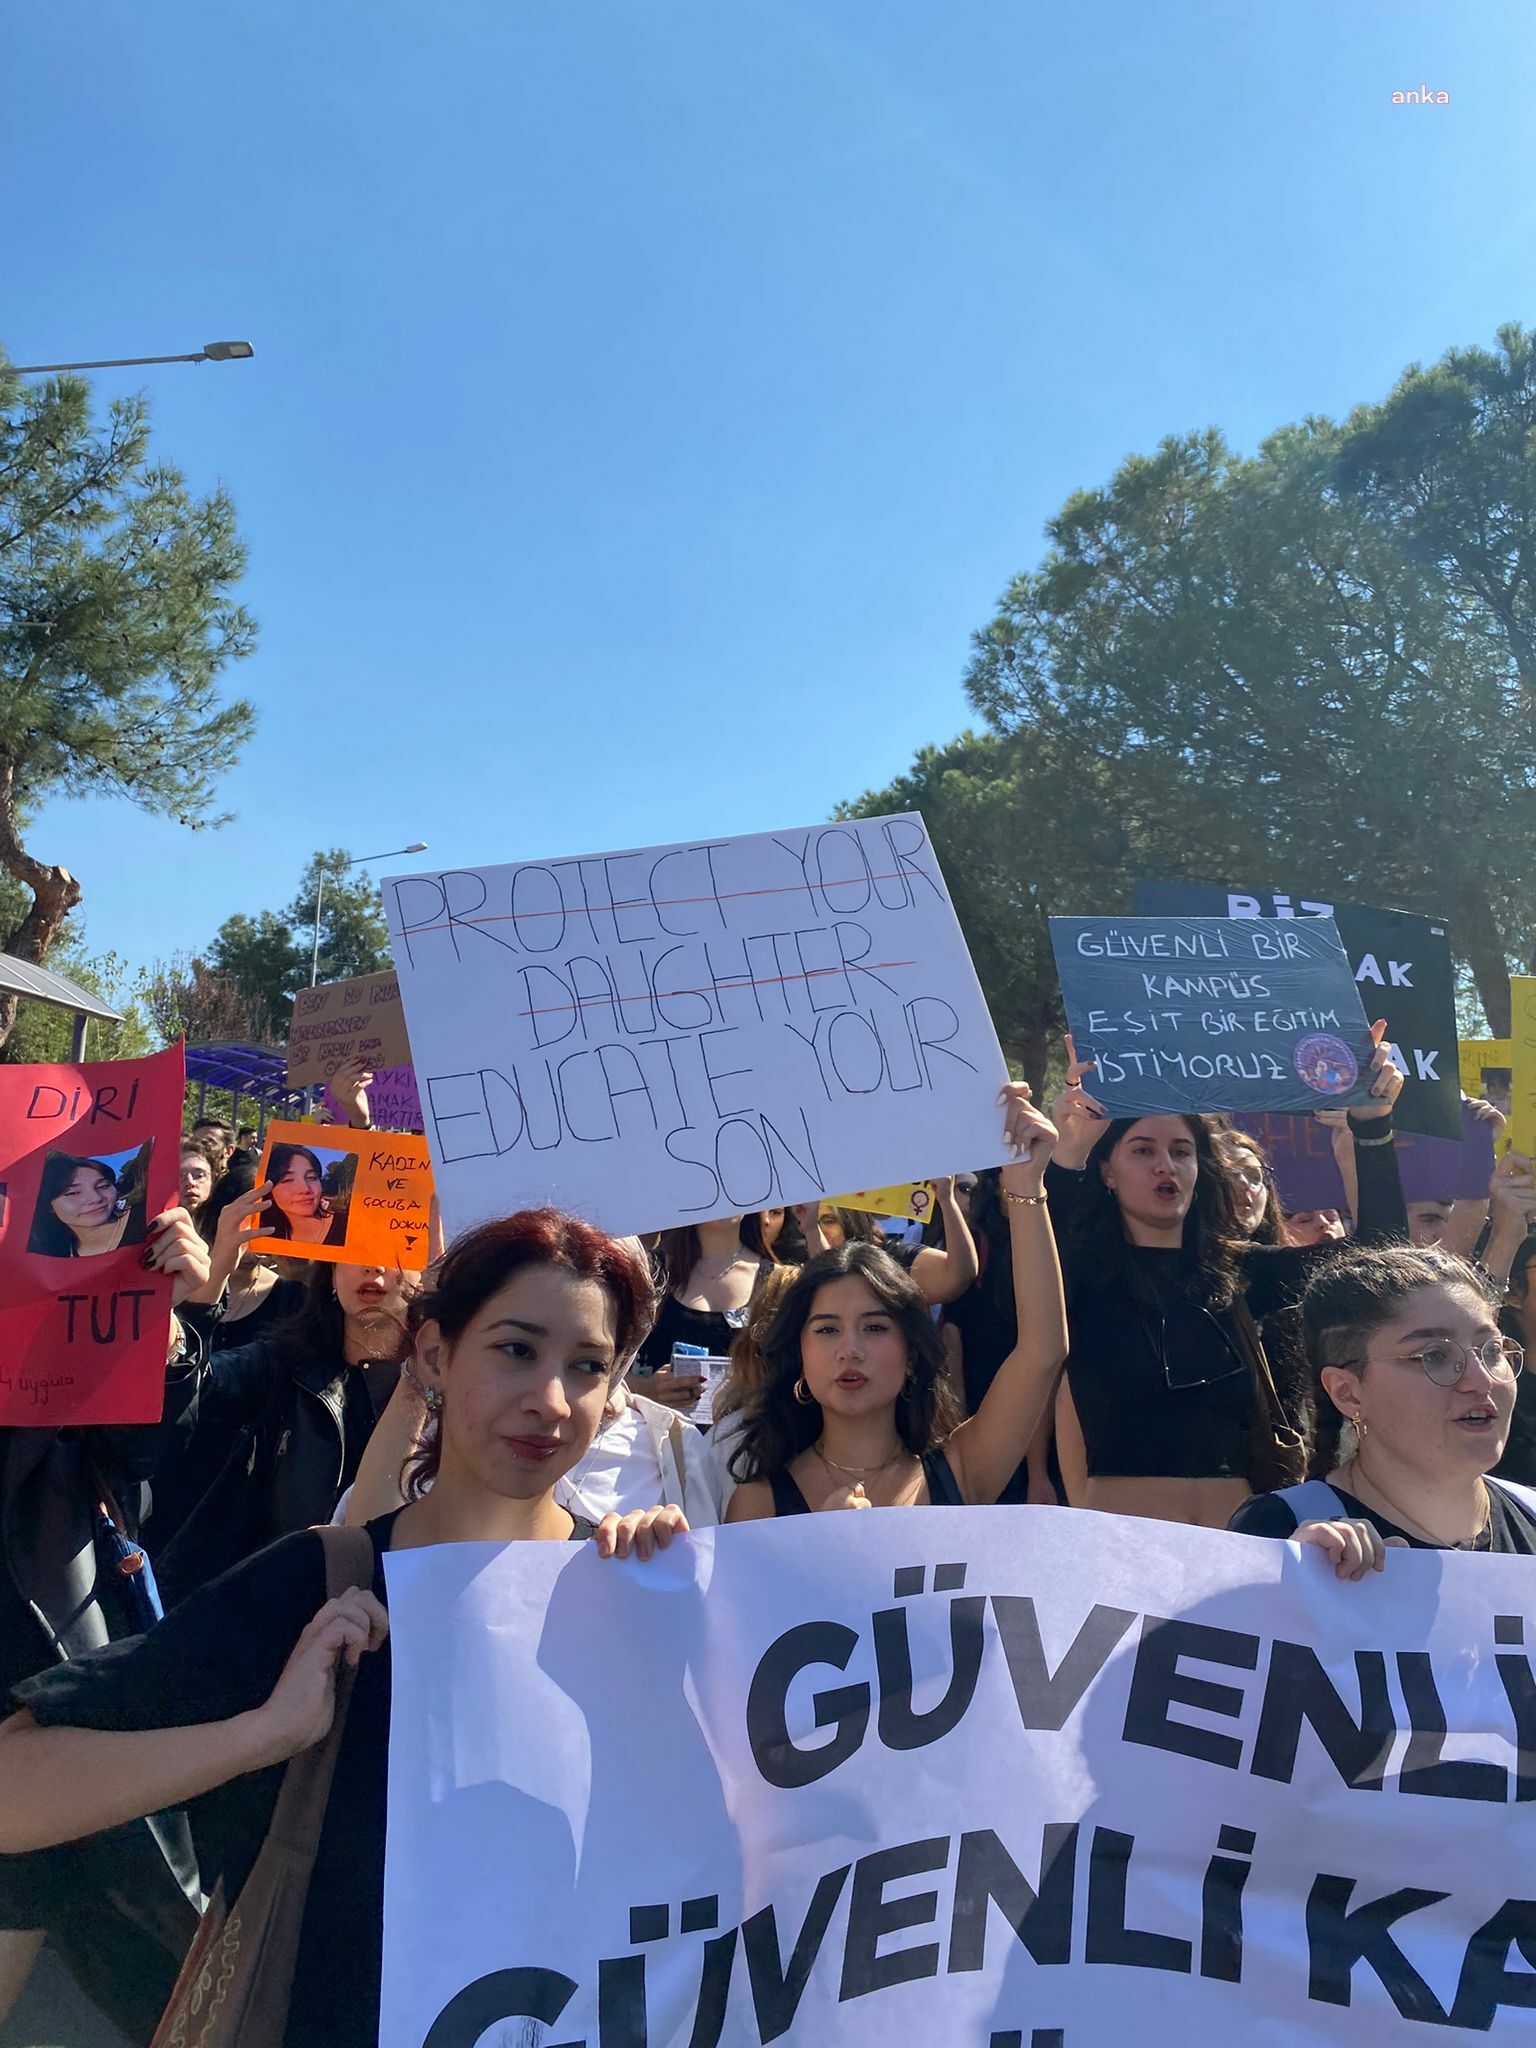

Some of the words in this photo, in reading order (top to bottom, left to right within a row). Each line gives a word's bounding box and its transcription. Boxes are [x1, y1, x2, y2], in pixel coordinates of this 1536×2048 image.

[391, 843, 730, 970] PROTECT
[772, 819, 946, 917] YOUR
[1077, 929, 1229, 958] GÜVENLİ
[1251, 930, 1311, 960] BİR
[517, 920, 900, 1051] DAUGHTER
[1141, 971, 1270, 998] KAMPÜS
[1354, 953, 1414, 988] AK
[1088, 1008, 1183, 1035] EŞİT
[1201, 1009, 1246, 1035] BİR
[1254, 1007, 1341, 1032] EĞİTİM
[426, 1027, 754, 1164] EDUCATE
[785, 996, 980, 1101] YOUR
[1387, 1042, 1441, 1081] AK
[369, 1151, 431, 1171] KADIN
[665, 1107, 826, 1212] SON
[389, 1218, 429, 1230] DOKUN
[57, 1289, 156, 1344] TUT
[746, 1562, 1536, 1803] GÜVENLİ
